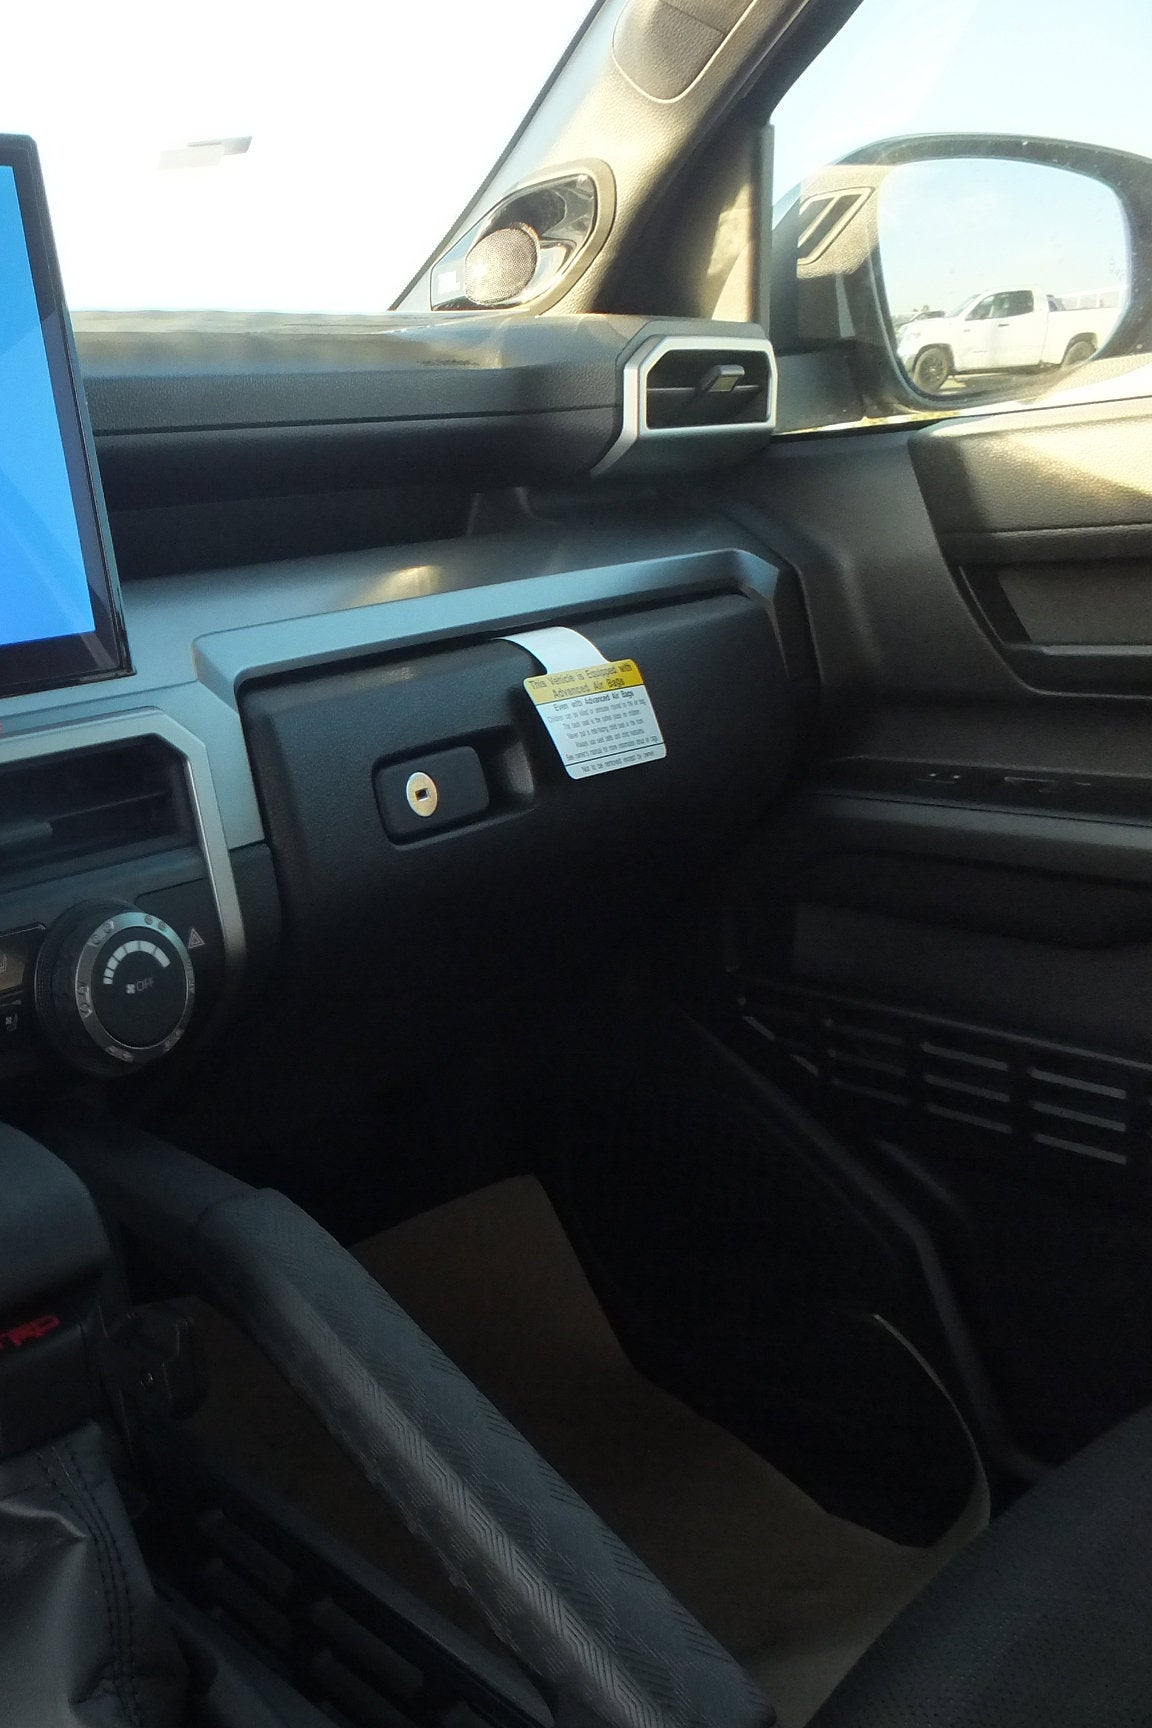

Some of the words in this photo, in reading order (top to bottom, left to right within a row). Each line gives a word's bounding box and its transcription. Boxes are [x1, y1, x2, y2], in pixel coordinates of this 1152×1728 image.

[529, 680, 547, 690] This
[547, 673, 576, 686] Vehicle
[577, 673, 584, 681] is
[585, 666, 618, 680] Equipped
[618, 663, 633, 673] with
[553, 683, 590, 699] Advanced
[593, 680, 604, 691] Air
[606, 678, 626, 689] Bags
[553, 703, 569, 711] Even
[571, 700, 583, 708] with
[584, 694, 611, 705] Advanced
[611, 691, 619, 699] Air
[620, 690, 635, 699] Bags
[135, 976, 155, 992] OFF
